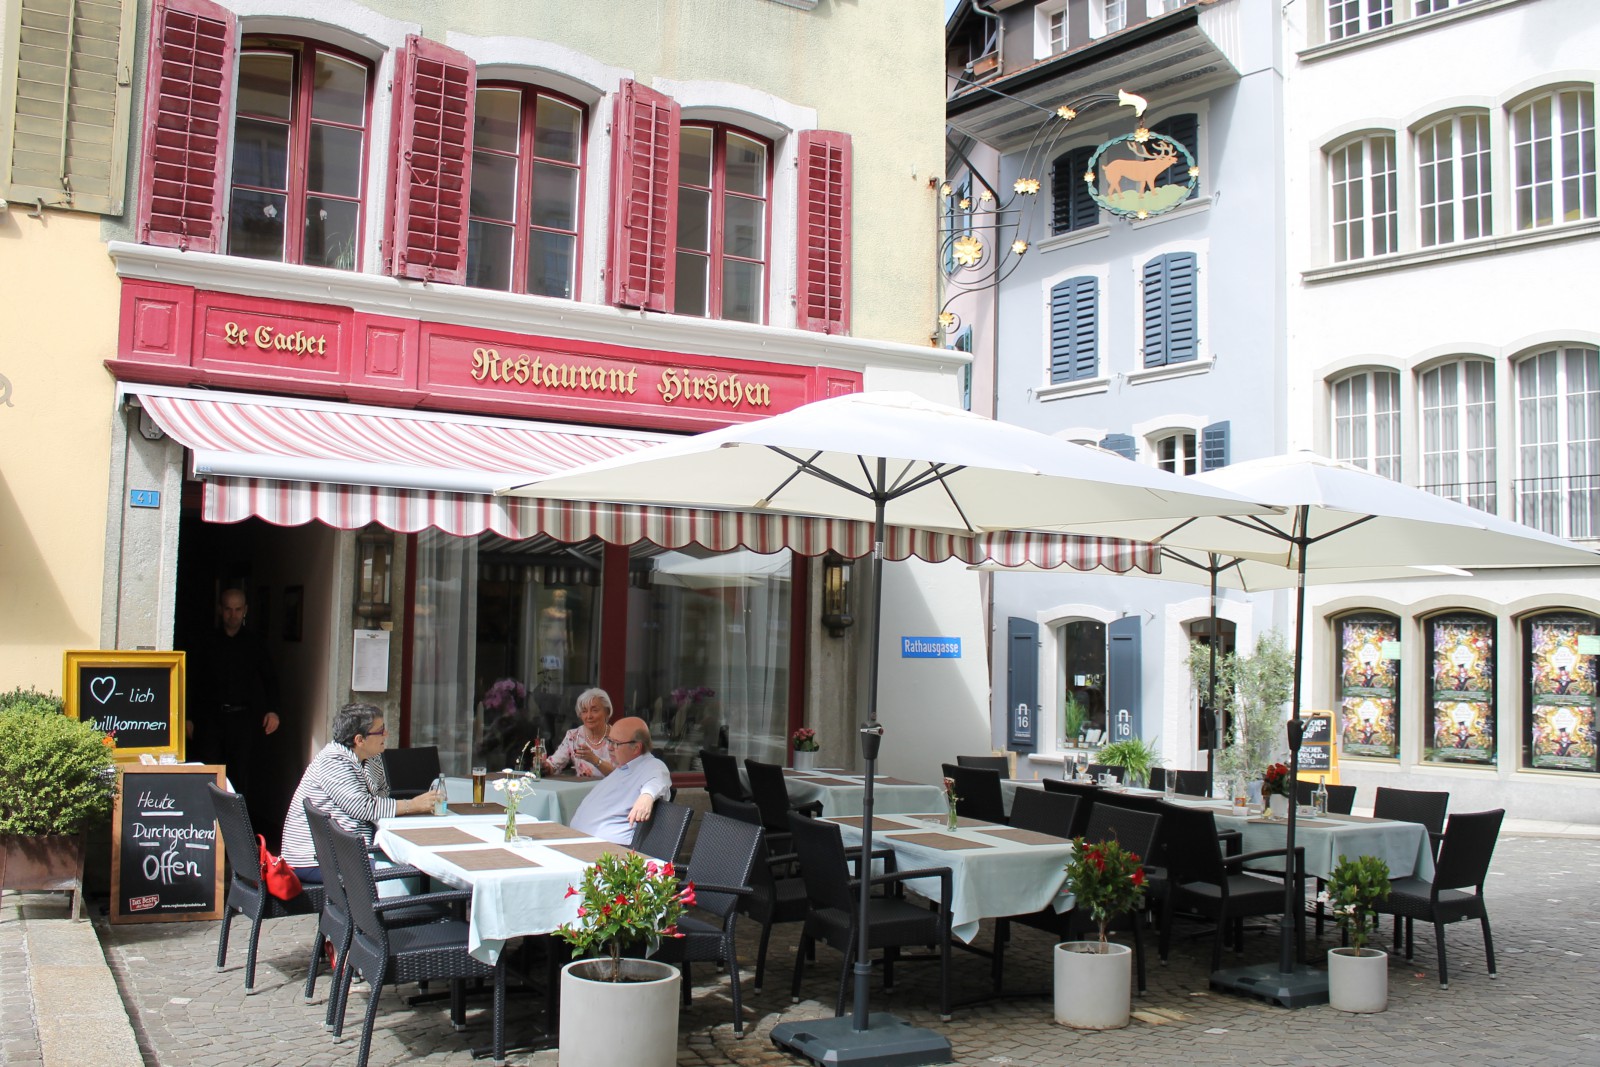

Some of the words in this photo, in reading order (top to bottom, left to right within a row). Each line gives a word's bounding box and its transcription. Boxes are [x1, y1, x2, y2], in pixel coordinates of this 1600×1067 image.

[224, 322, 248, 346] Le
[254, 325, 327, 355] Cachet
[471, 347, 638, 395] Restaurant
[656, 367, 771, 408] Hirschen
[137, 492, 153, 504] 41
[904, 639, 959, 656] Rathausgasse
[1017, 716, 1029, 728] 16
[1117, 723, 1130, 736] 16
[137, 791, 176, 810] Heute
[143, 851, 201, 885] Offen
